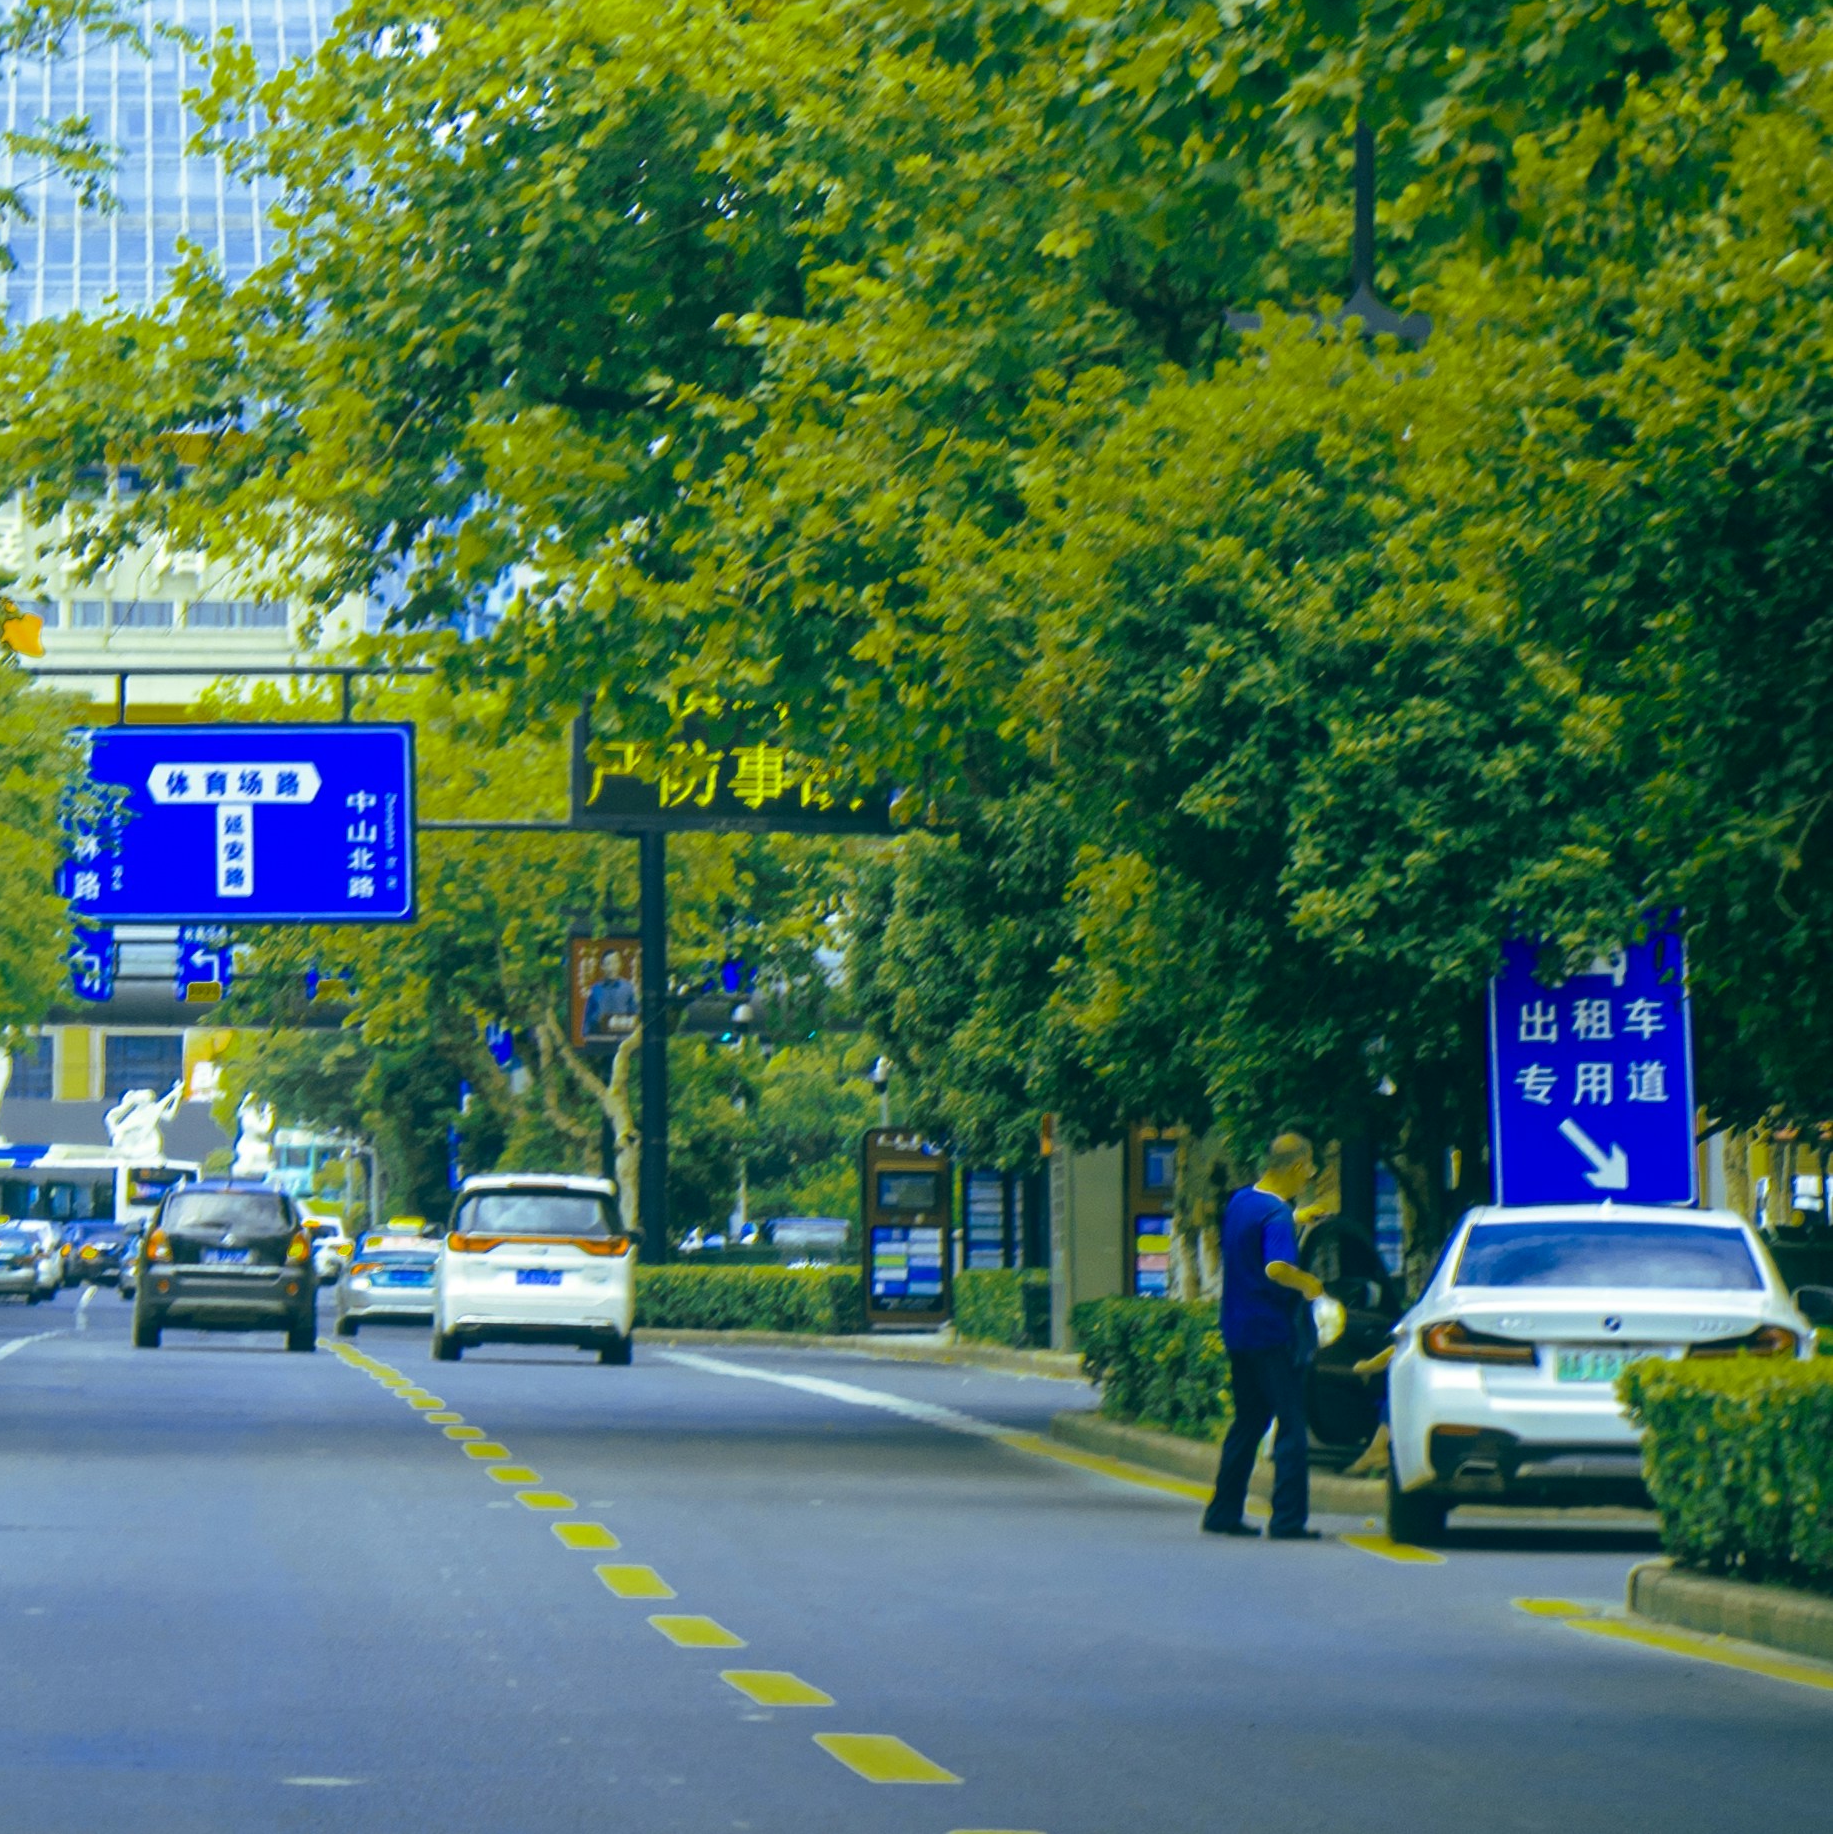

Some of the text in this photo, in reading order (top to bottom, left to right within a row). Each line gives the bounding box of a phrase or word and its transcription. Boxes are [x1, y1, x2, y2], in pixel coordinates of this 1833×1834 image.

[166, 769, 300, 797] 体育场路
[223, 814, 245, 889] 延安路
[346, 790, 377, 900] 中山北路
[1518, 996, 1667, 1044] 出租车
[1513, 1059, 1670, 1106] 专用道
